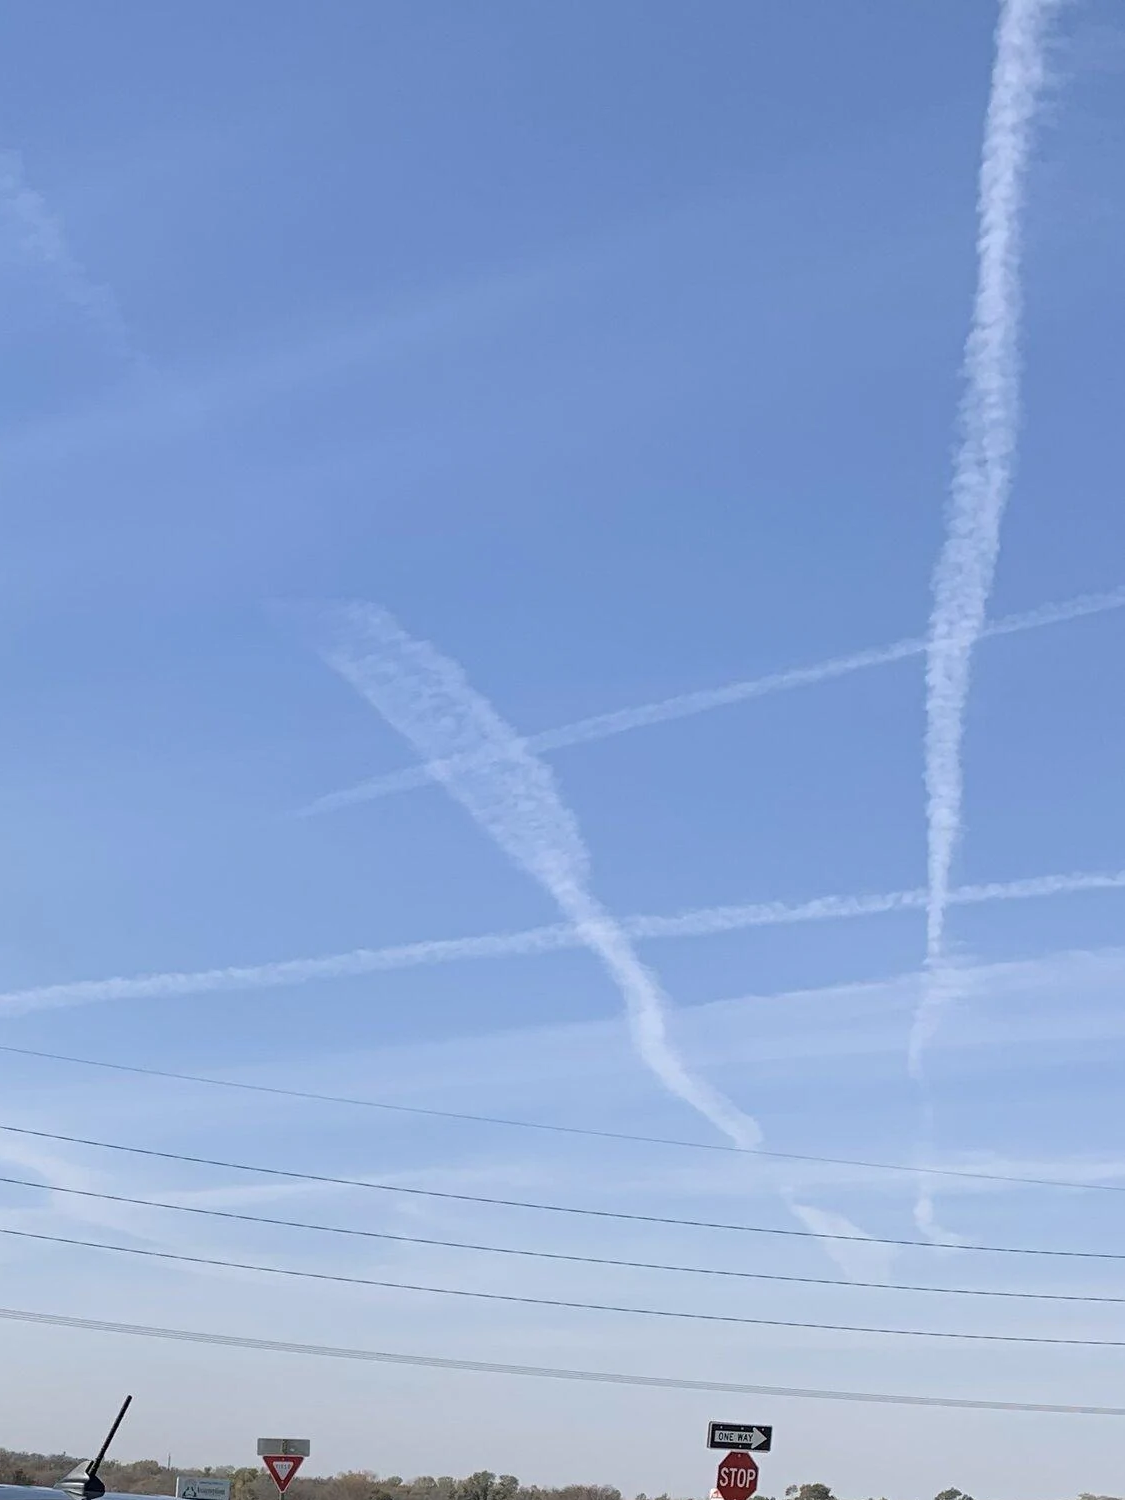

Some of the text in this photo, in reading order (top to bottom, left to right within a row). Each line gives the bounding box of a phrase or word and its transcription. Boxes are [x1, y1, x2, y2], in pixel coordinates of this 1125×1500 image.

[718, 1432, 753, 1442] ONE WAY
[719, 1467, 756, 1488] STOP
